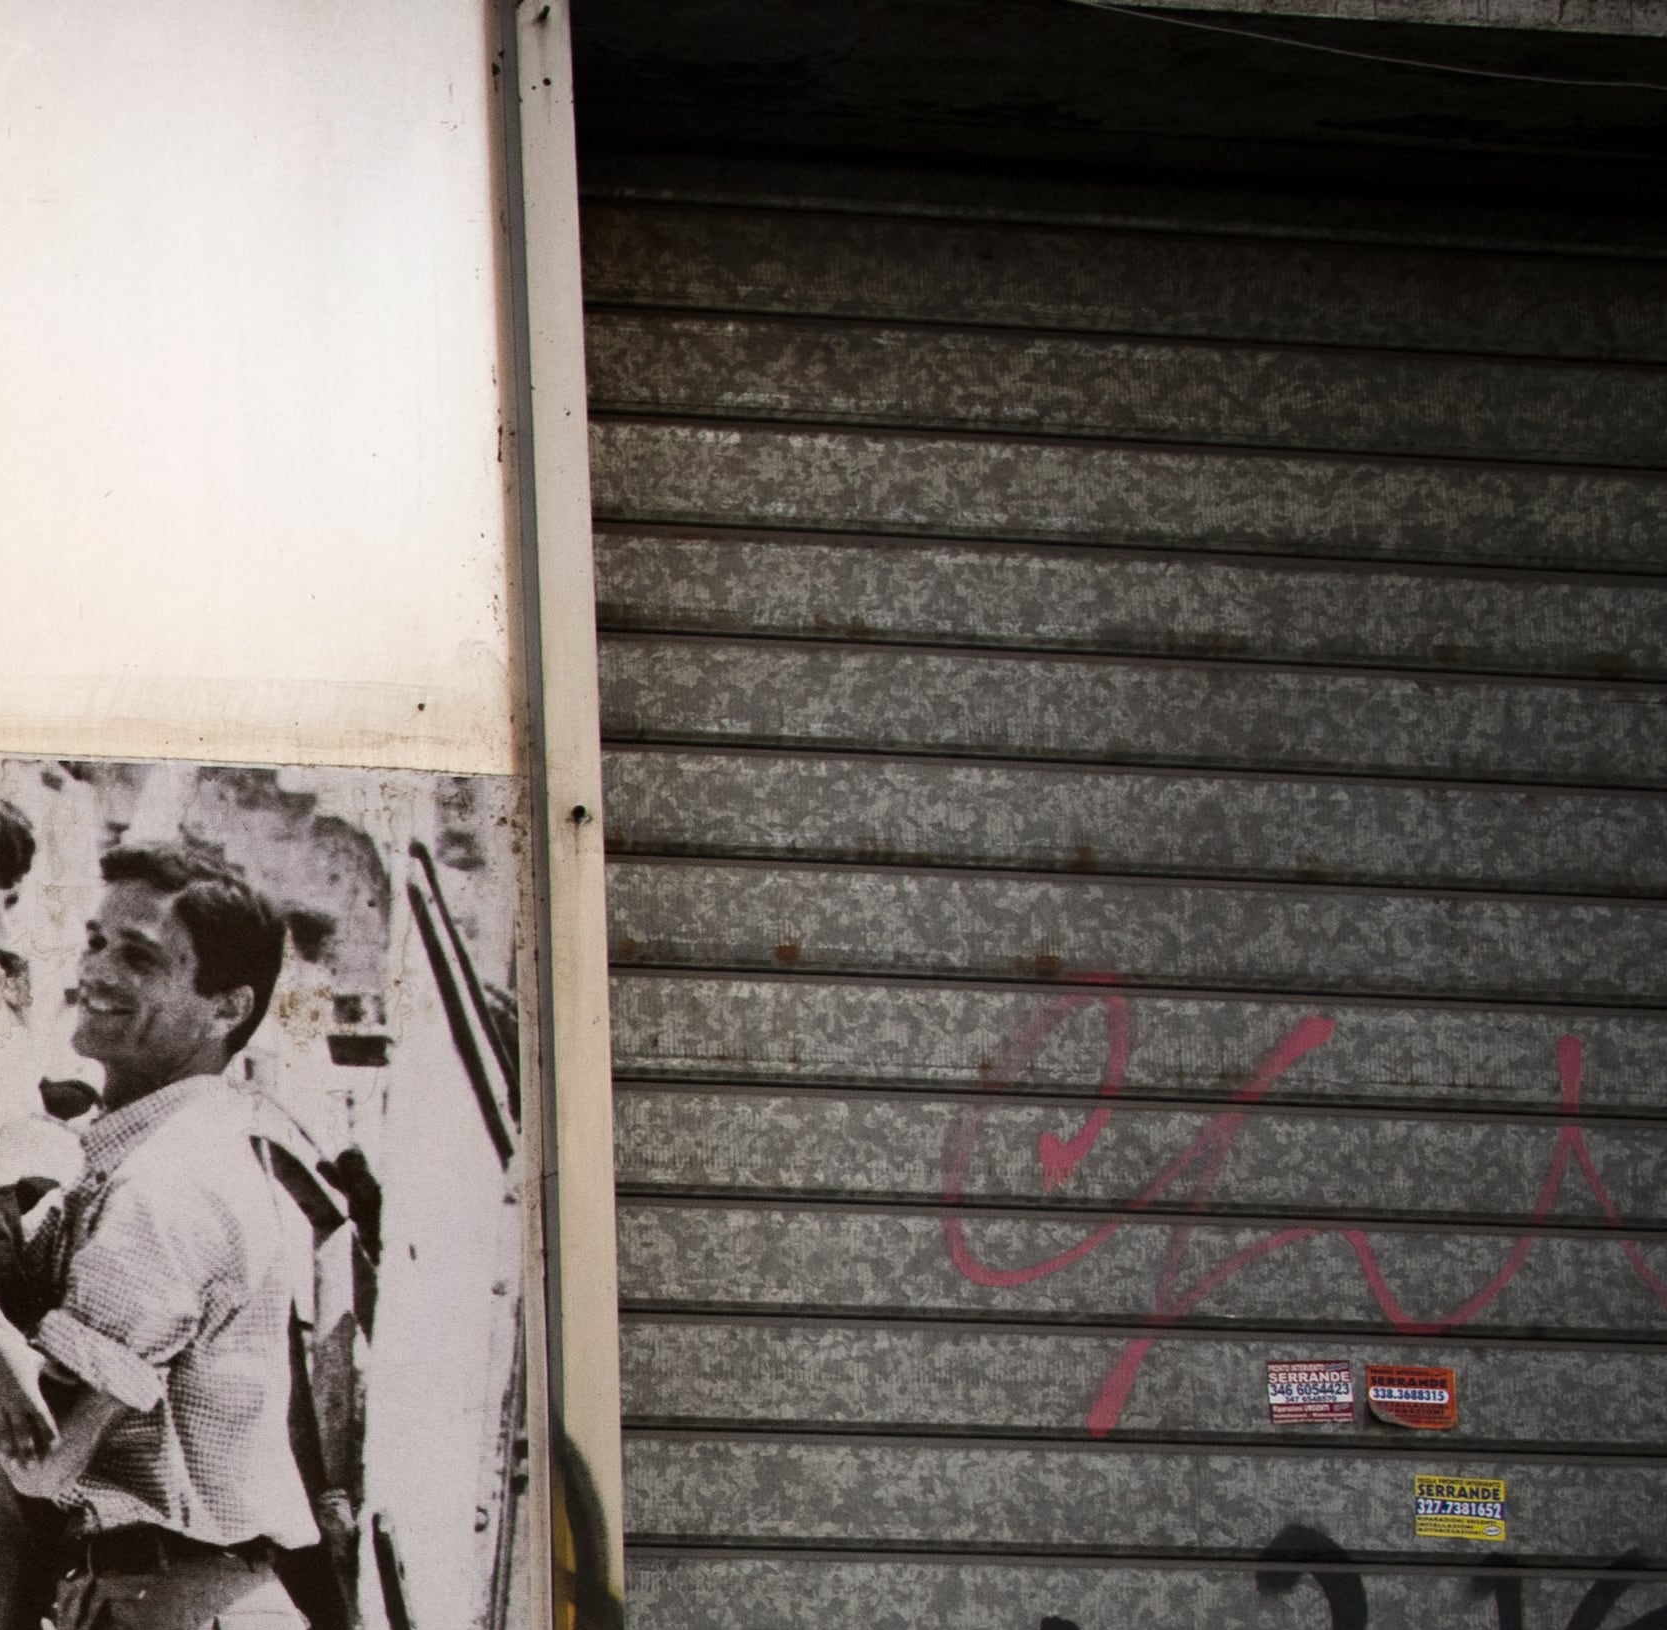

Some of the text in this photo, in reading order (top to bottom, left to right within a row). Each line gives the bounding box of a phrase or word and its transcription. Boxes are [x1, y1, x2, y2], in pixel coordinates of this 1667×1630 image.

[1268, 1372, 1349, 1383] SERRANDE
[1371, 1375, 1447, 1388] SERRANDE
[1270, 1383, 1349, 1396] 346 6054423
[1373, 1388, 1445, 1401] 338.3688315
[1417, 1485, 1501, 1500] SERRANDE
[1417, 1499, 1502, 1518] 327.7381652
